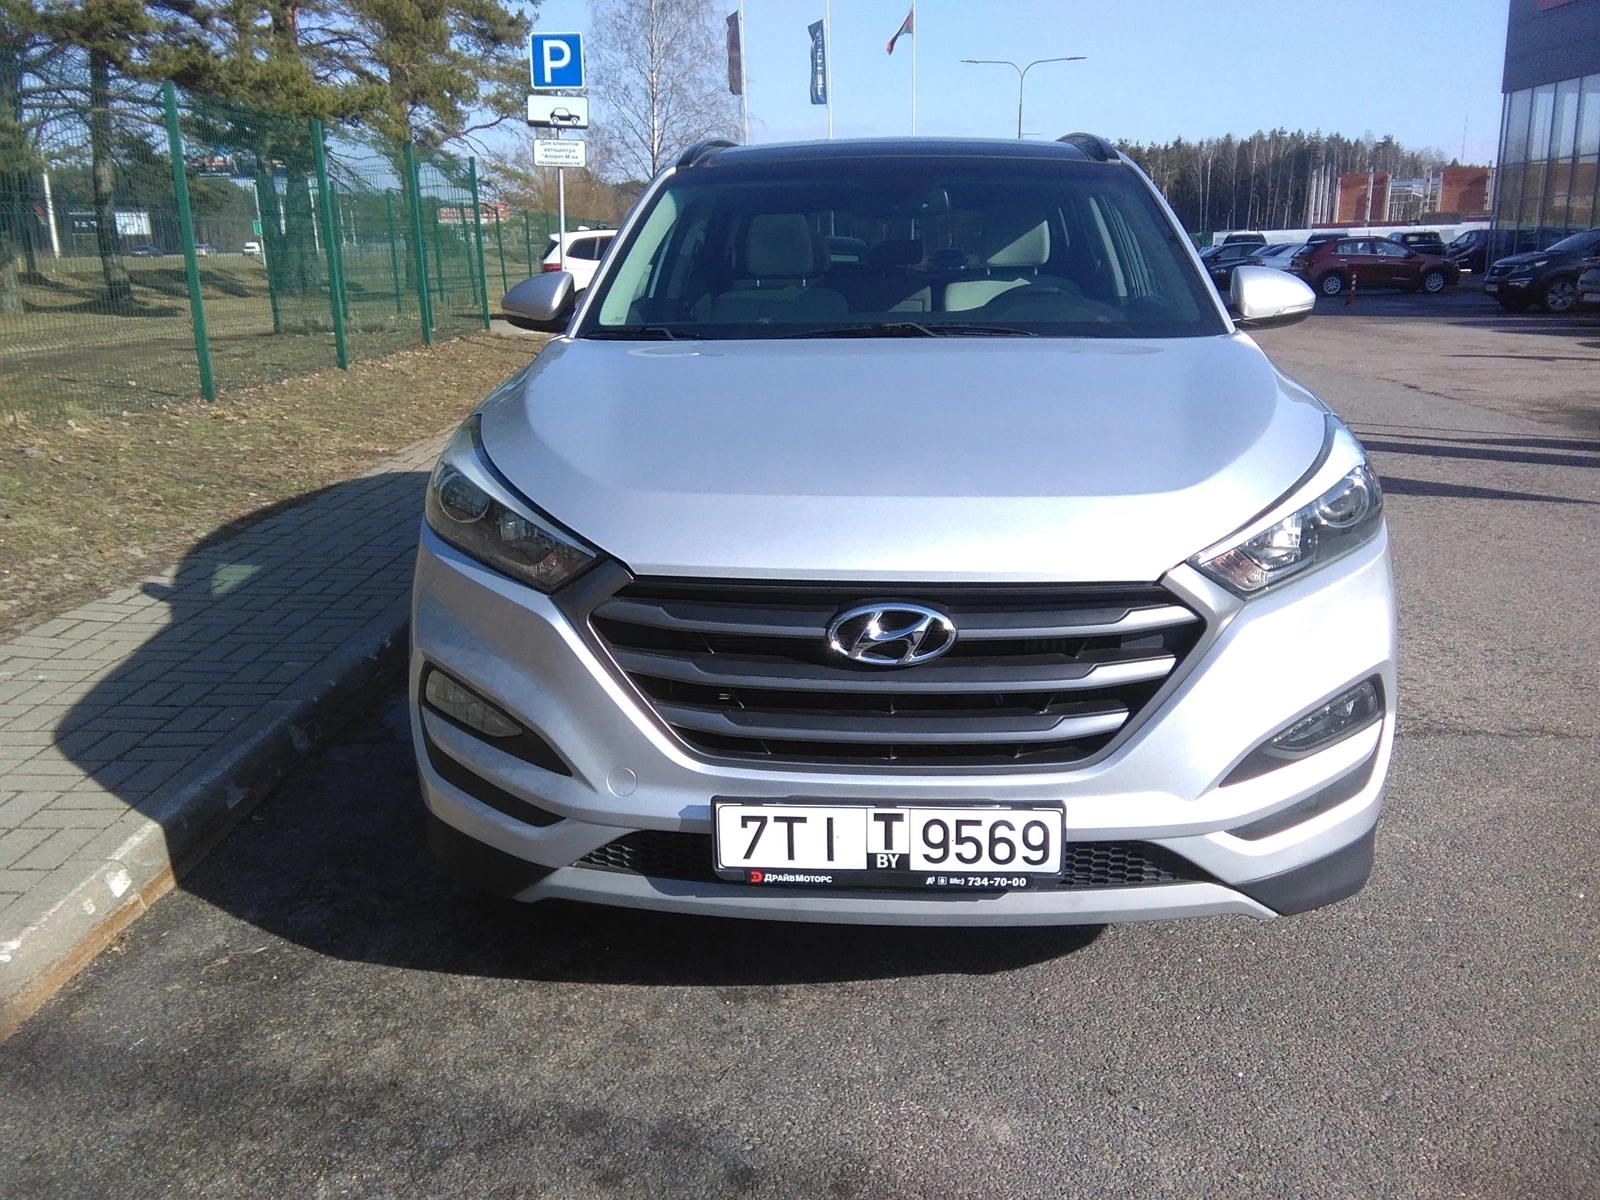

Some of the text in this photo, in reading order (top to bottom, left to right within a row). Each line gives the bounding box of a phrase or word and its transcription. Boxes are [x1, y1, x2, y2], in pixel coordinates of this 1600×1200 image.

[542, 39, 571, 83] P
[873, 812, 905, 851] T
[922, 818, 1050, 866] 9569
[876, 853, 900, 869] BY
[967, 876, 1027, 887] 734-70-00
